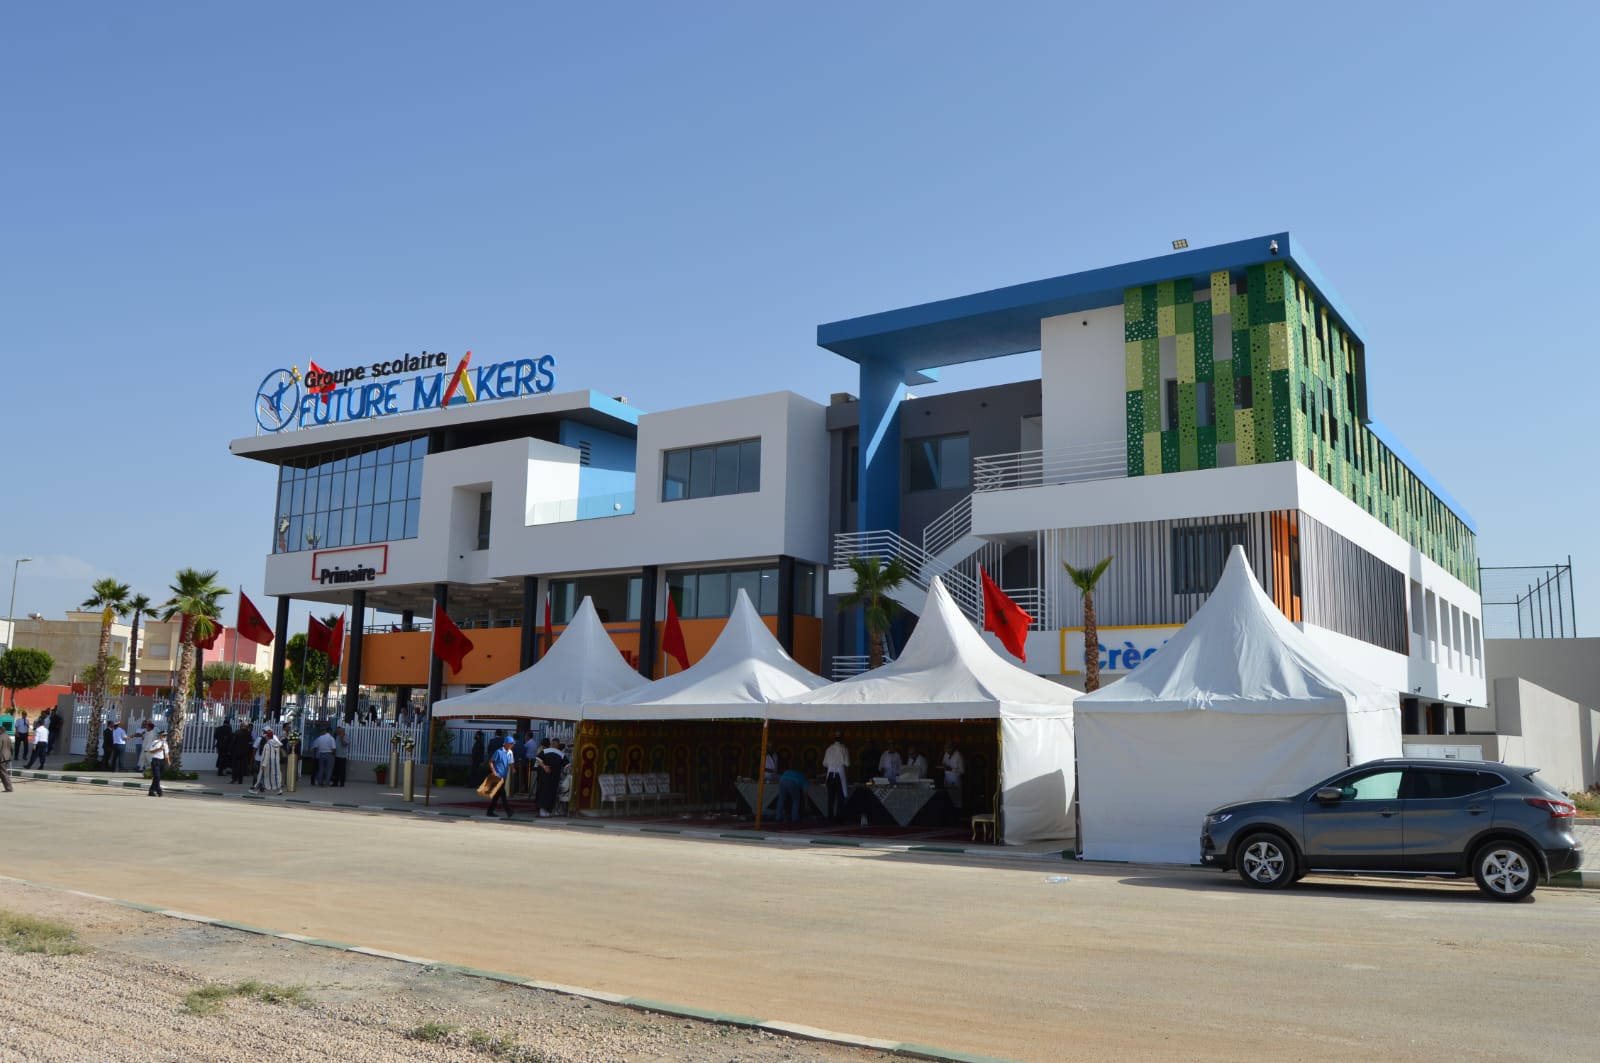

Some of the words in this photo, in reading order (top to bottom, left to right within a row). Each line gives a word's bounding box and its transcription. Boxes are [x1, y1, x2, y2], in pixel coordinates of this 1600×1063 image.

[304, 365, 366, 388] Groupe
[371, 350, 447, 378] scolaire
[299, 379, 402, 427] FUTURE
[413, 350, 555, 411] MAKERS
[320, 563, 376, 585] Primaire
